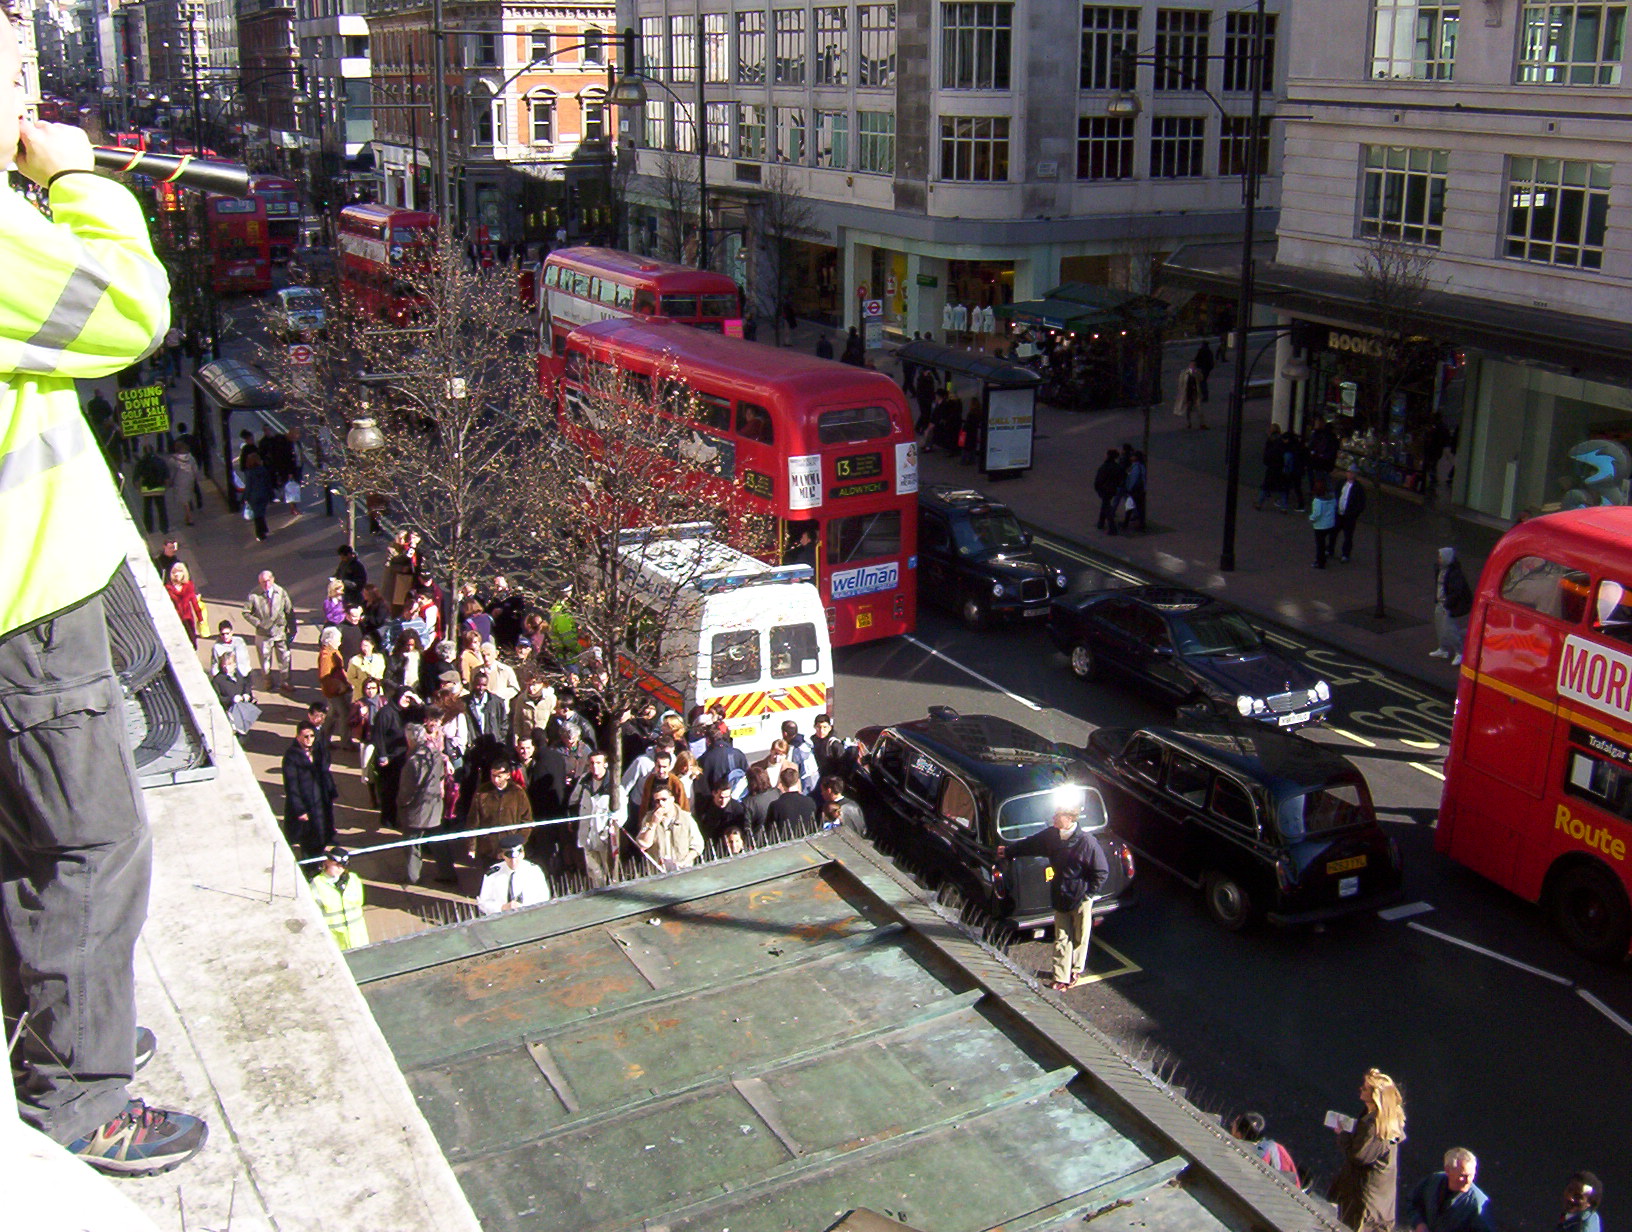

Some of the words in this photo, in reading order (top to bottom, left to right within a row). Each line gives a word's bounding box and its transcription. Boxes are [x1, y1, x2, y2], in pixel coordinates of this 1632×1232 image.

[118, 386, 162, 401] CLOSING
[125, 397, 159, 410] DOWN
[837, 460, 850, 476] 13
[791, 473, 820, 487] MAMMA
[839, 483, 881, 497] ALDWYCH
[833, 568, 897, 592] wellman
[1560, 643, 1632, 712] MOR
[1589, 735, 1626, 759] Trafalgar
[1555, 804, 1626, 861] Route
